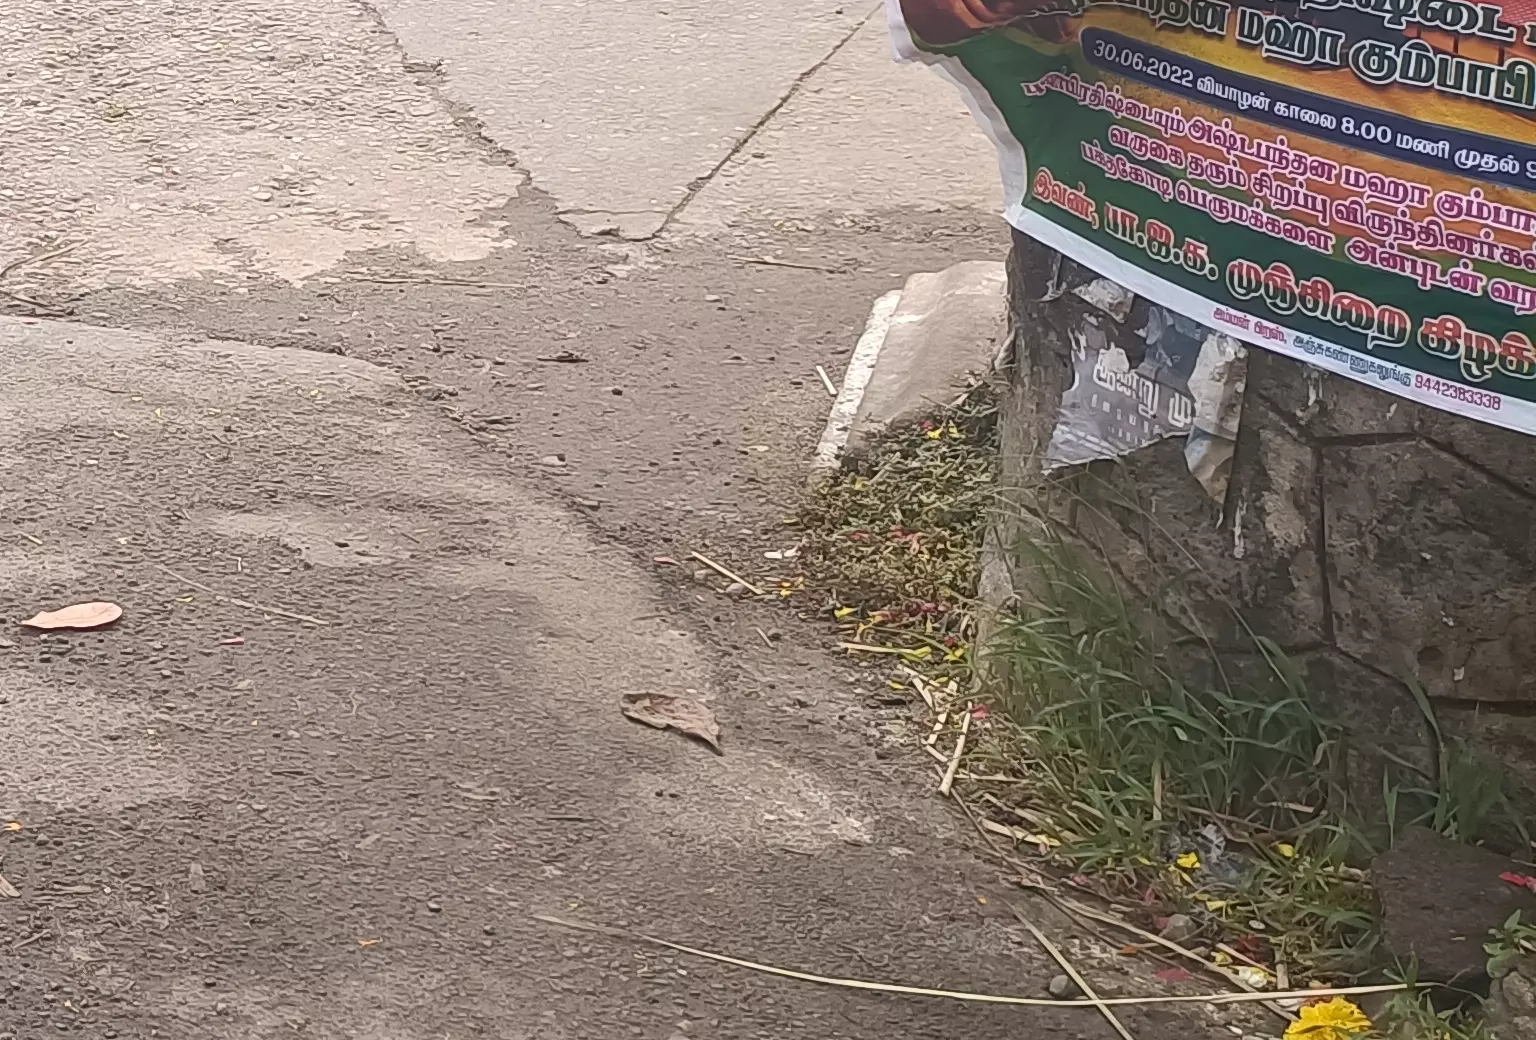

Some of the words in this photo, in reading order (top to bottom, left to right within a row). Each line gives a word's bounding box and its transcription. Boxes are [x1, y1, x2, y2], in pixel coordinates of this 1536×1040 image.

[1234, 4, 1346, 67] மஹா
[1093, 39, 1194, 88] 30.06.2022
[1196, 75, 1271, 112] வியாழன்
[1273, 99, 1337, 131] காலை
[1340, 116, 1392, 145] 8.00
[1395, 132, 1451, 160] மணி
[1454, 147, 1520, 175] முதல்
[1108, 124, 1186, 170] வருகை
[1186, 153, 1248, 189] தரும்
[1249, 170, 1330, 225] சிறப்பு
[1187, 117, 1338, 183] அஷ்டபந்தன
[1340, 164, 1432, 207] மஹா
[1175, 178, 1335, 255] பெருமக்களை
[1344, 236, 1487, 296] அன்புடன்
[1225, 257, 1412, 351] முஞ்சிறை
[1414, 373, 1502, 411] 9442383338
